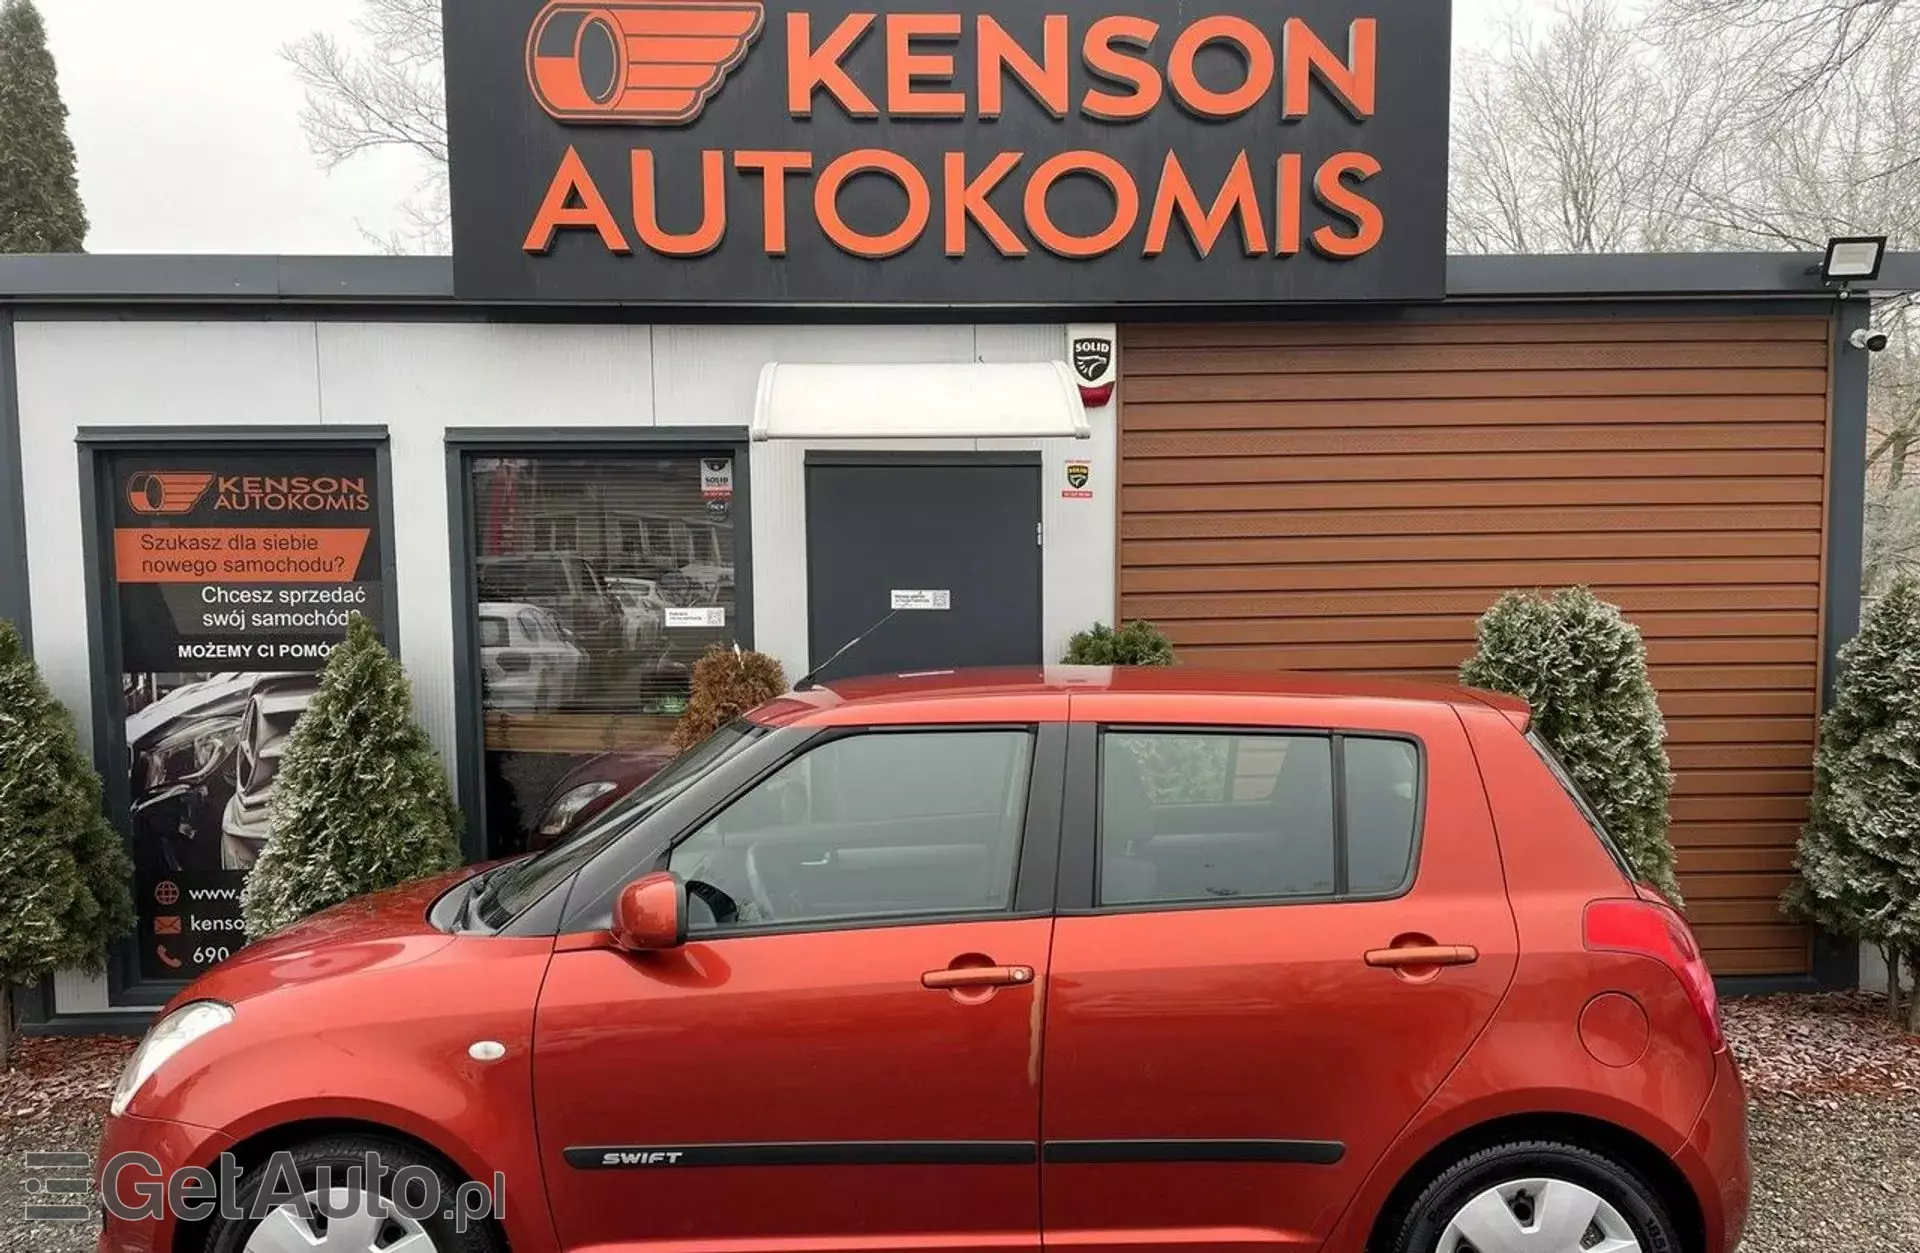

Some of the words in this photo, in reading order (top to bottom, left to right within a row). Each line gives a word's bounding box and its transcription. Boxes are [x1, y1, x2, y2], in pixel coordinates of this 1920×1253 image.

[786, 12, 1377, 121] KENSON
[522, 144, 1385, 259] AUTOKOMIS
[1075, 342, 1109, 352] SOLID
[218, 476, 365, 494] KENSON
[213, 493, 370, 511] AUTOKOMIS
[141, 534, 221, 551] Szukasz
[228, 534, 257, 551] dla
[263, 534, 318, 551] siebie
[142, 558, 217, 576] nowego
[223, 556, 345, 573] samochodu?
[201, 586, 273, 603] Chcesz
[279, 586, 366, 607] sprzedać
[202, 610, 246, 630] swój
[178, 642, 253, 658] MOŻEMY
[257, 645, 274, 658] CI
[193, 946, 229, 963] 690
[602, 1152, 683, 1165] SWIFT
